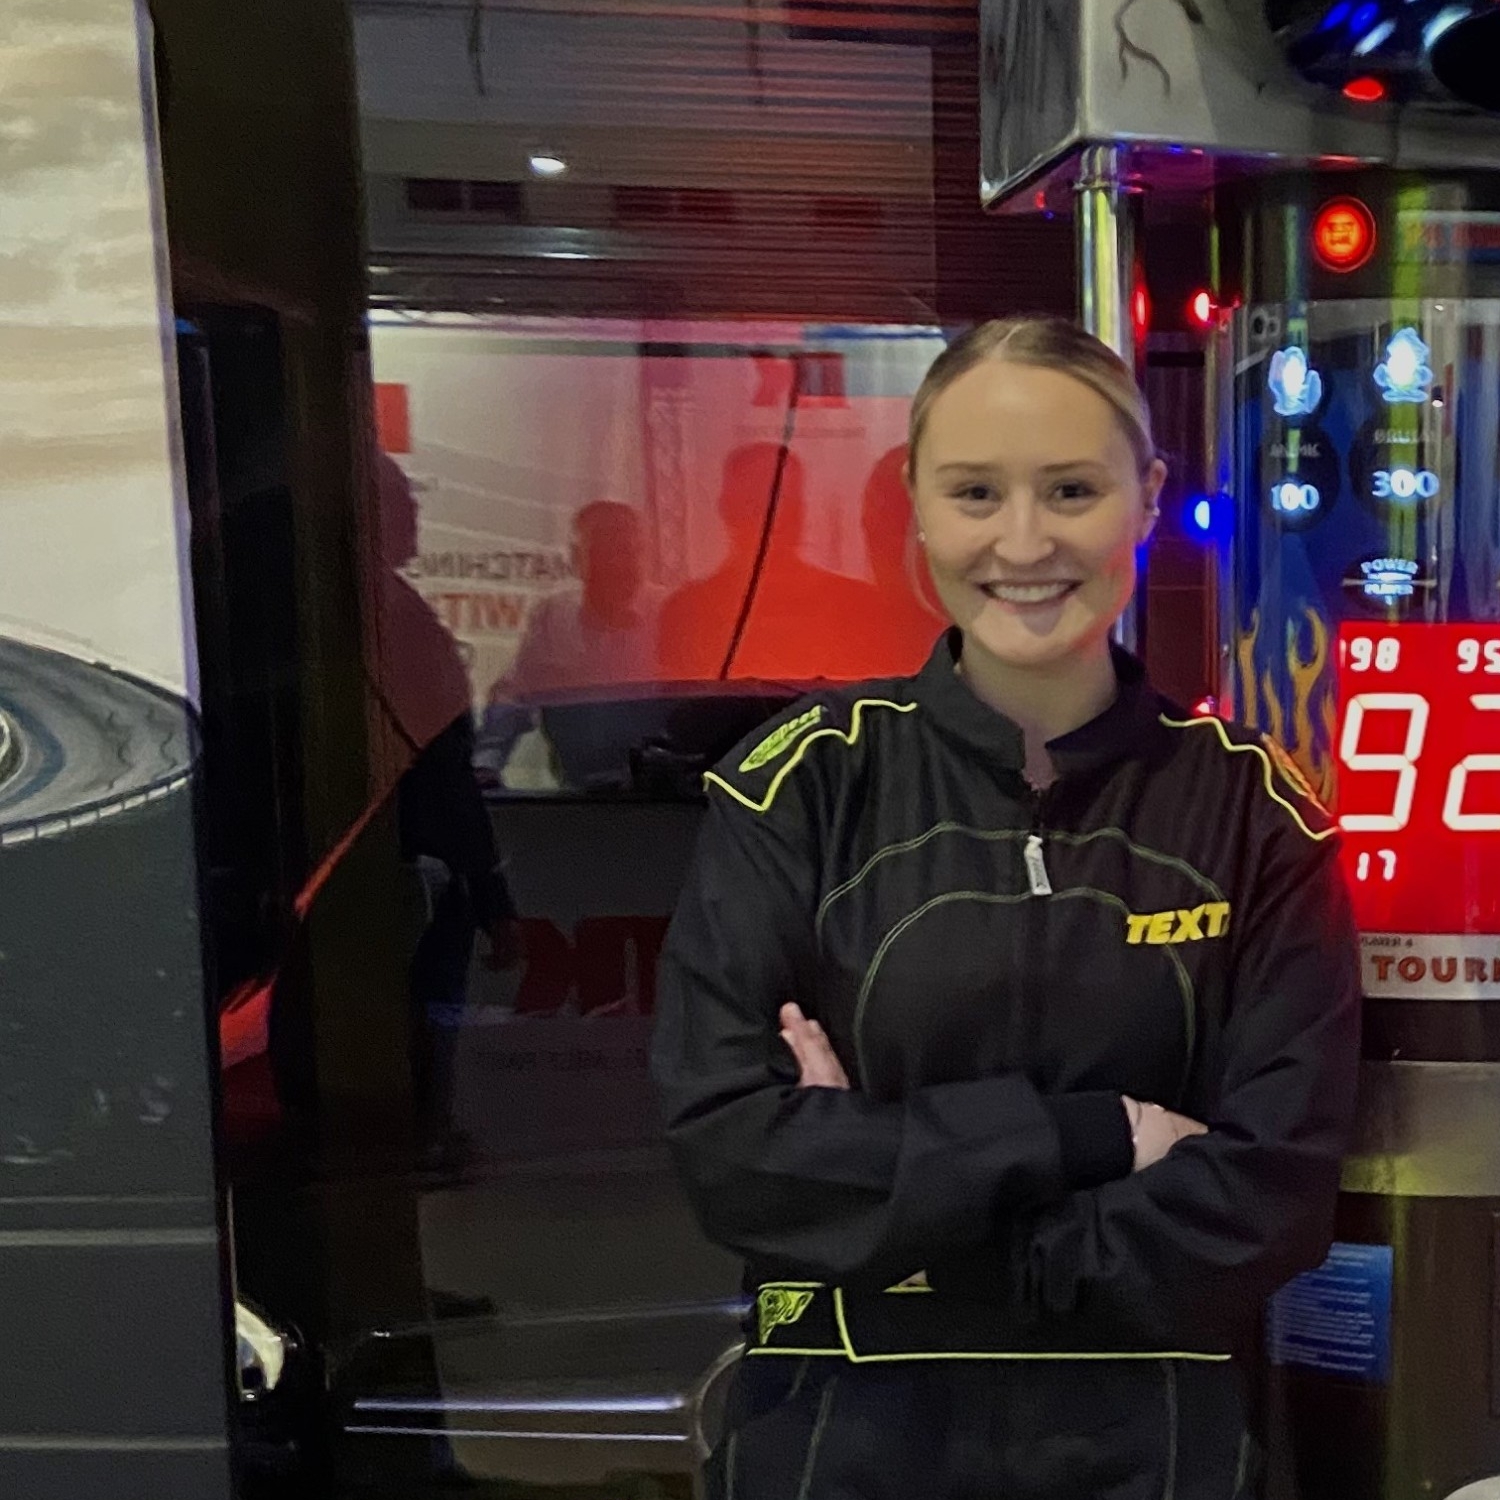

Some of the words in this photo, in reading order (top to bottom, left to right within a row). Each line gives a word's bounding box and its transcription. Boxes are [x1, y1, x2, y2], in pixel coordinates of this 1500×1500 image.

[1270, 482, 1320, 511] 100
[1371, 468, 1440, 499] 300
[1356, 848, 1397, 881] 17
[1126, 901, 1230, 945] TEXT
